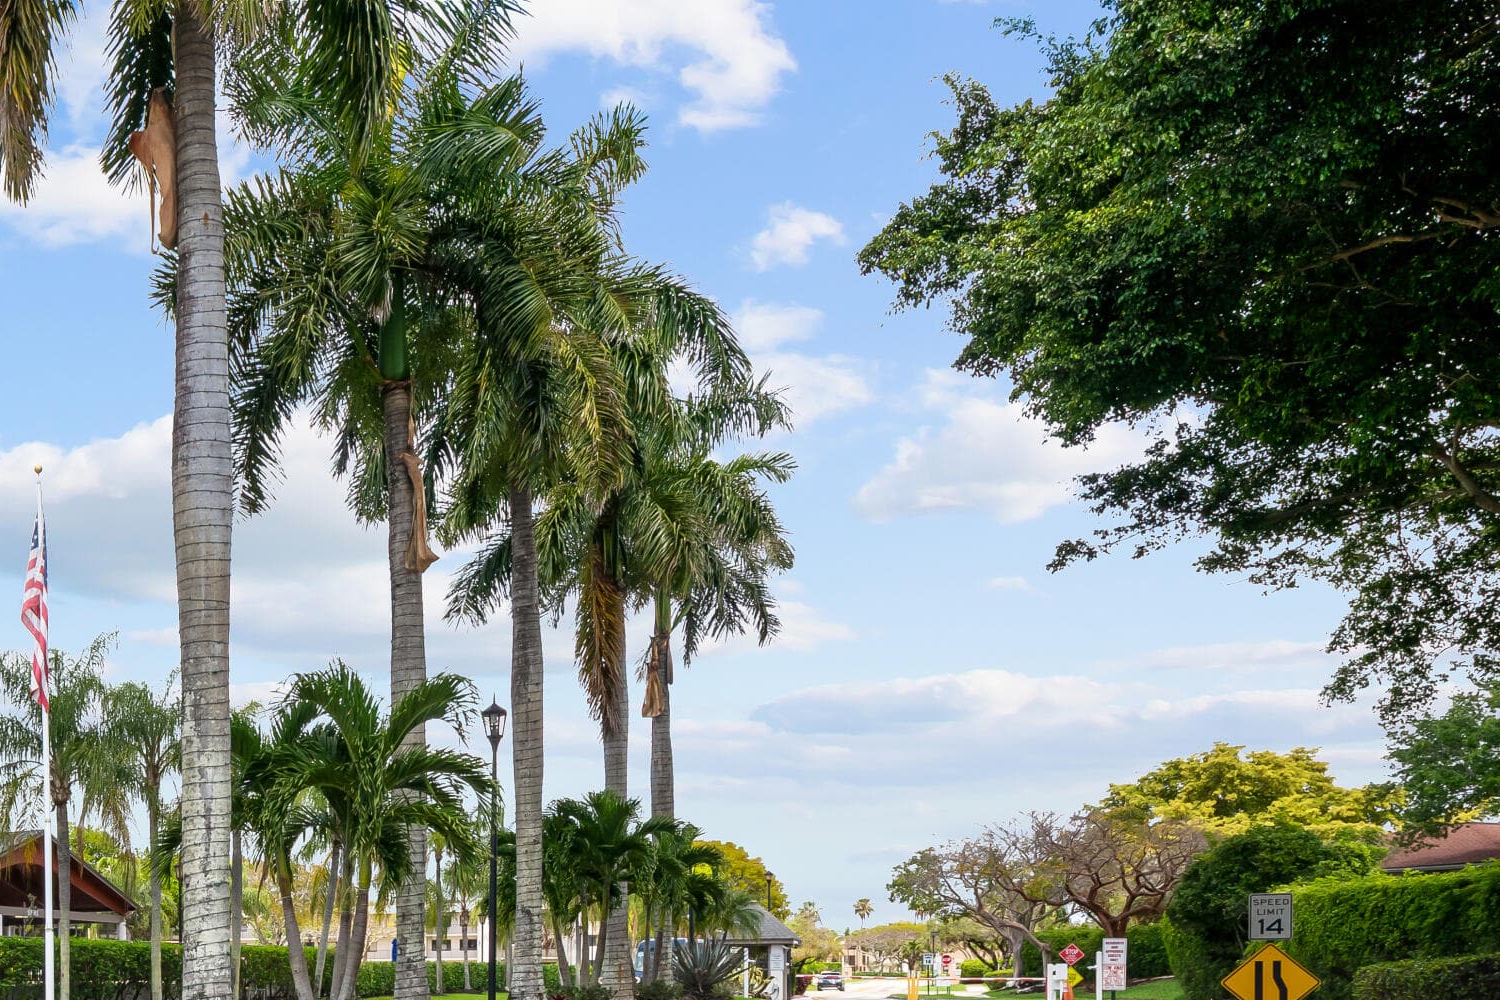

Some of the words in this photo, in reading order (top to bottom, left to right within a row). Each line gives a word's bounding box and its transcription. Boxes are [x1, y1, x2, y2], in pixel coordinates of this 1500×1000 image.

[1253, 898, 1289, 906] SPEED
[1257, 908, 1284, 916] LIMIT
[1258, 918, 1284, 935] 14
